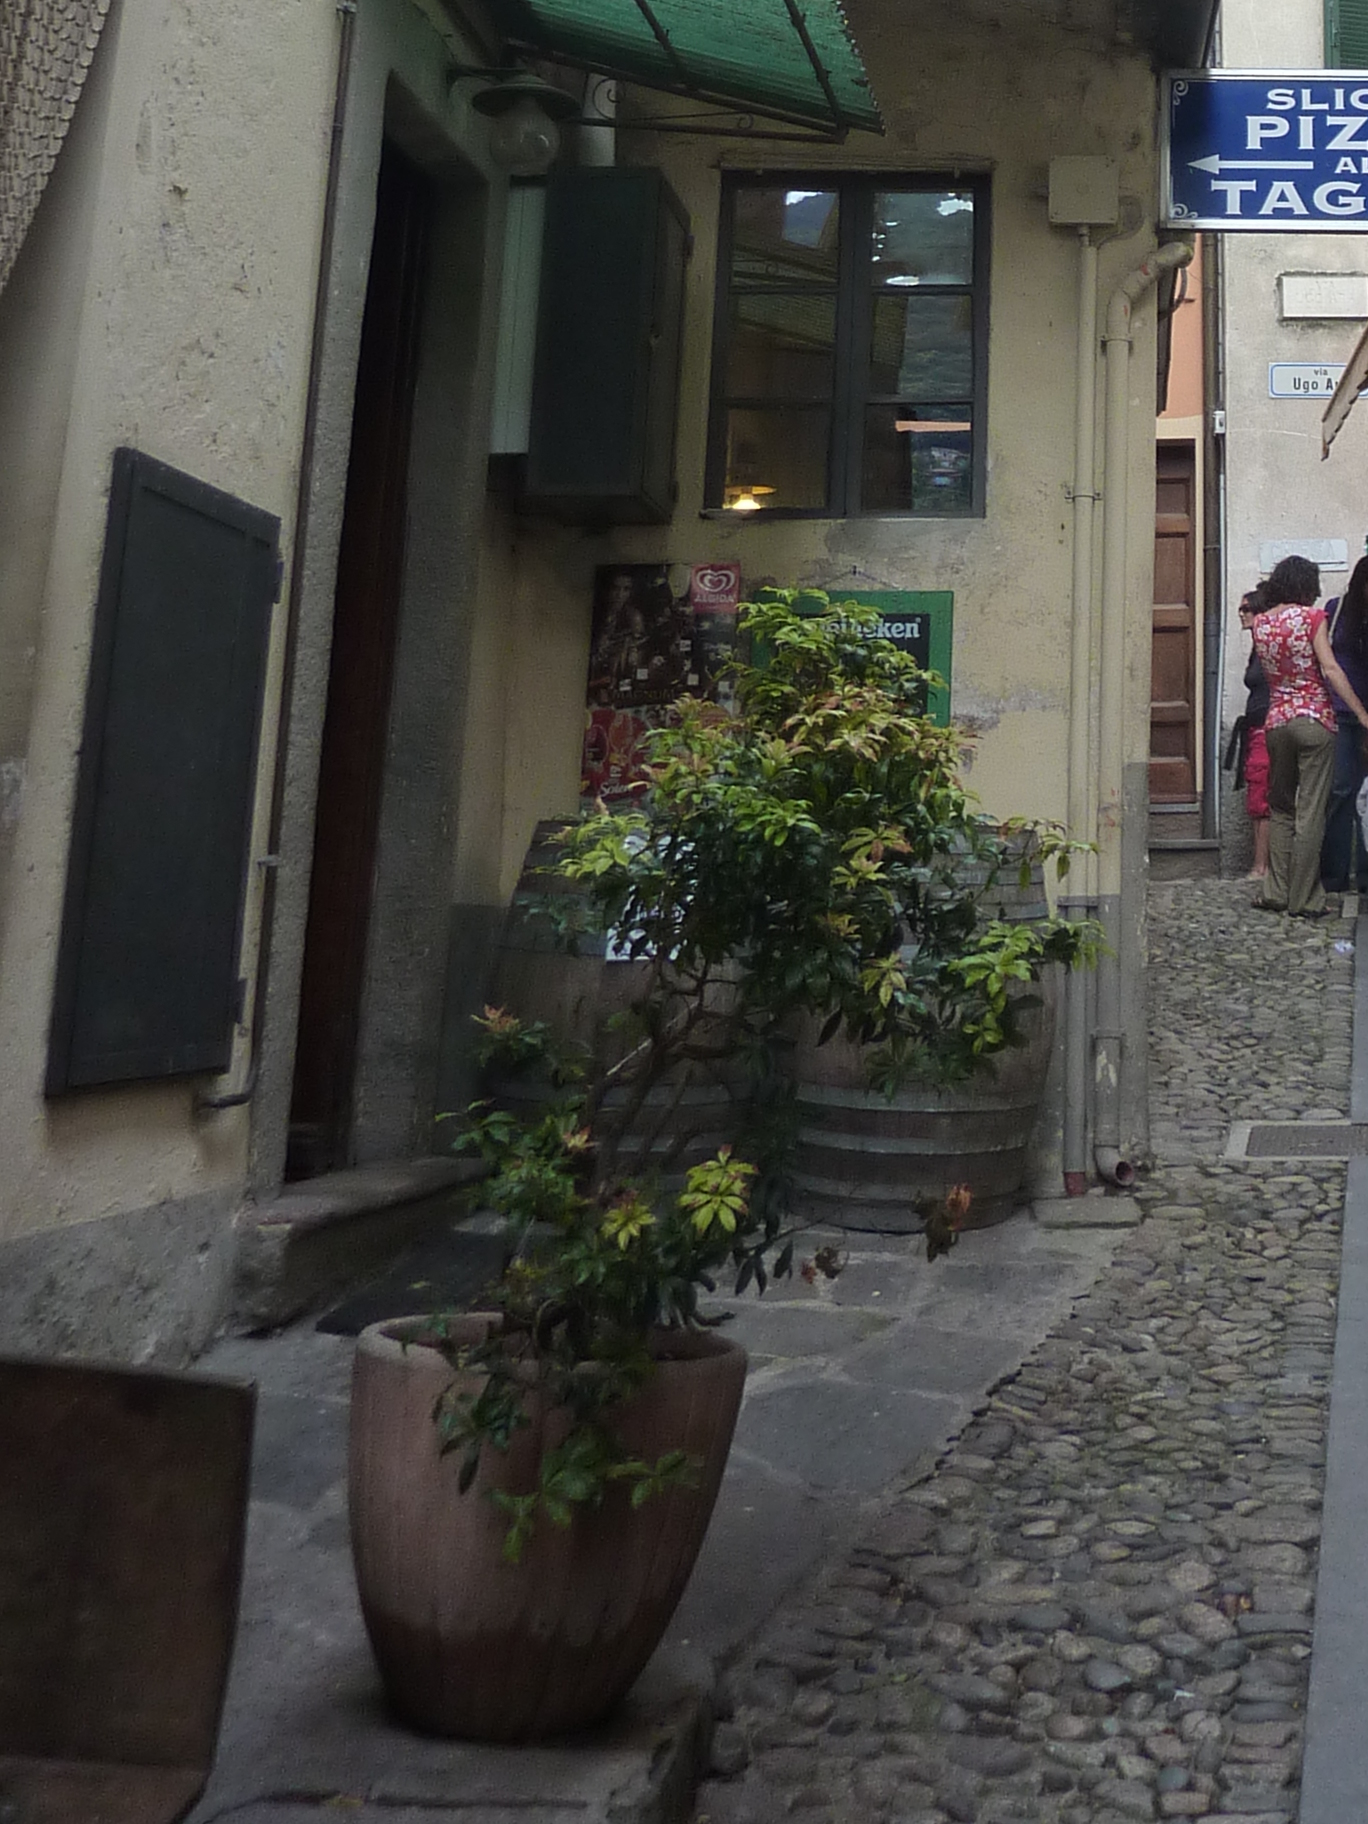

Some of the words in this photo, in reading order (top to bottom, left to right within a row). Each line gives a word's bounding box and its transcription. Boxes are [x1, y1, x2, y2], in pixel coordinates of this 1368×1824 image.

[1313, 367, 1328, 376] via
[1293, 377, 1319, 393] Ugo
[694, 594, 735, 603] ALGIDA
[822, 617, 920, 639] eieken
